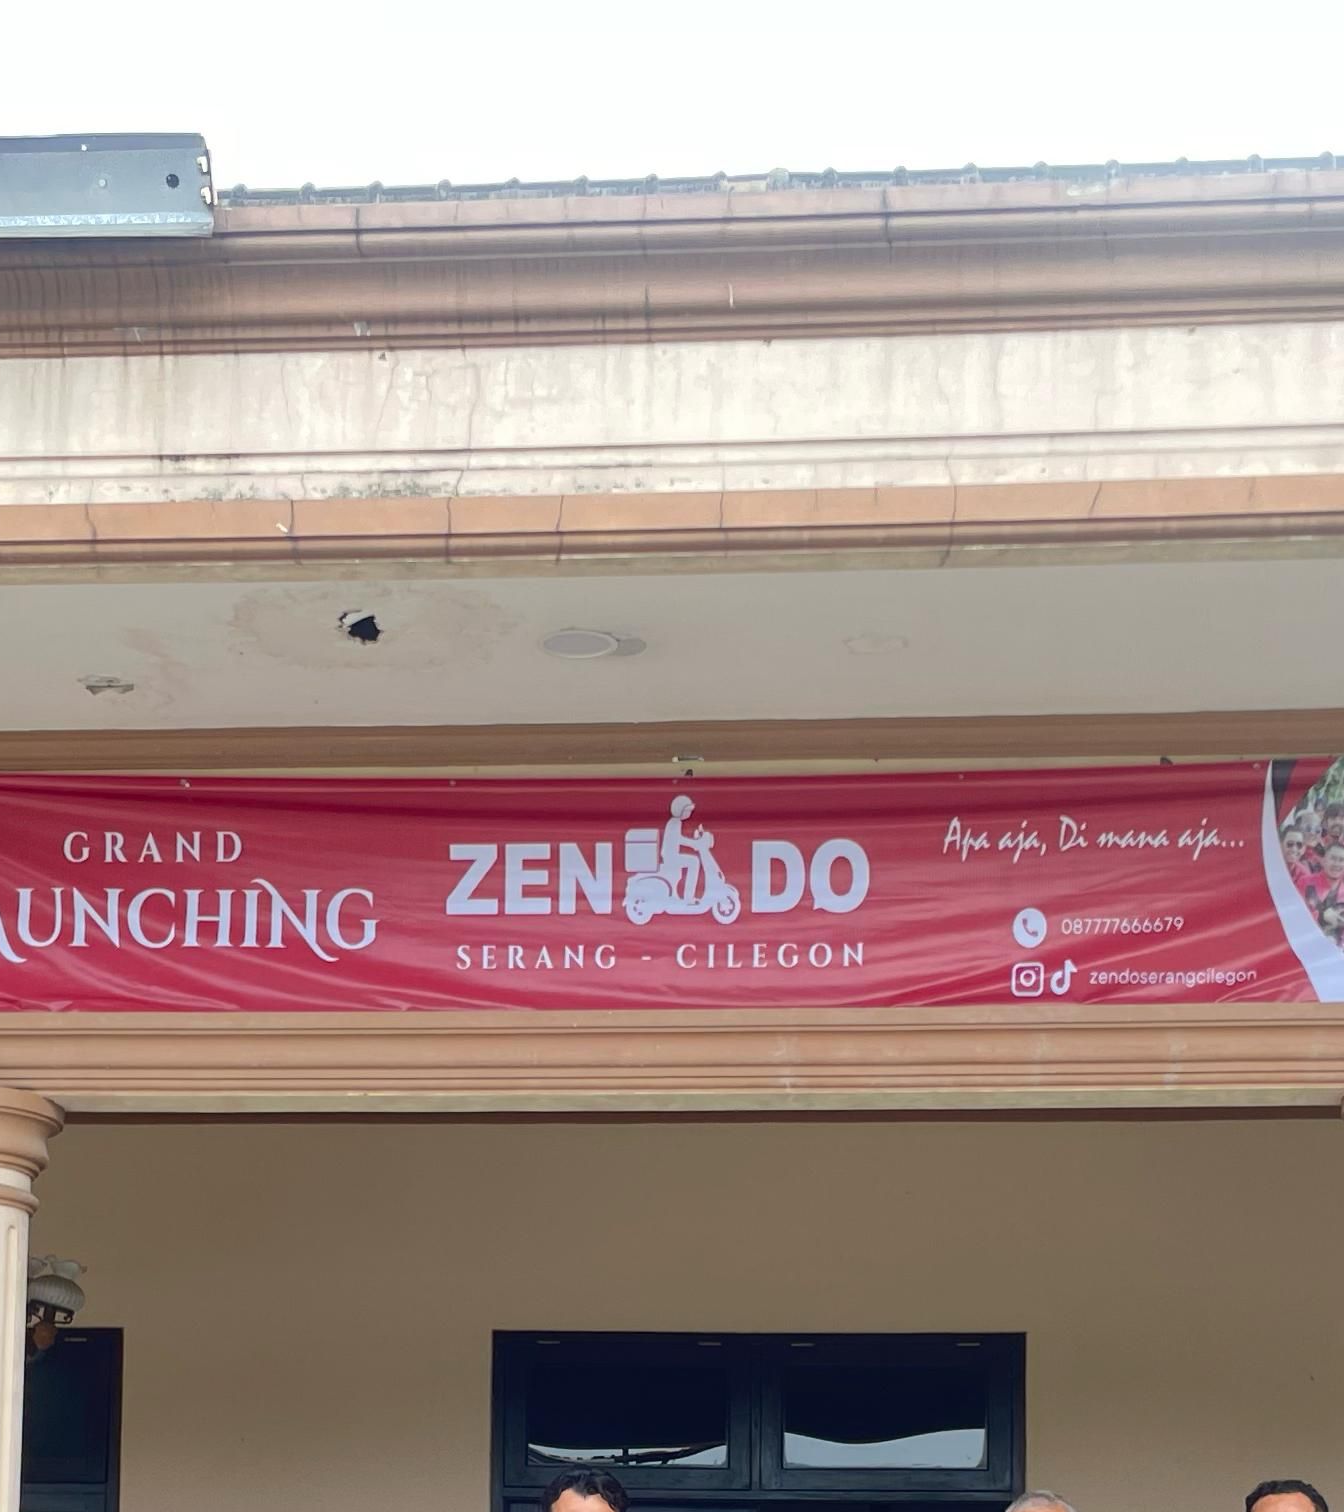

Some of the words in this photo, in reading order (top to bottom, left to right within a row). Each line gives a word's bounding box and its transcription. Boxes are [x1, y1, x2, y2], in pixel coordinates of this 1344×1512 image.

[63, 831, 243, 864] GRAND
[942, 816, 991, 862] Apa
[998, 820, 1047, 864] aja,
[1059, 815, 1089, 852] Di
[1096, 829, 1170, 850] mana
[1177, 818, 1246, 862] aja...
[1060, 916, 1185, 935] 087777666679
[456, 944, 616, 971] SERANG
[676, 942, 864, 970] CILEGON
[1088, 967, 1258, 989] zendoserangcilegon
